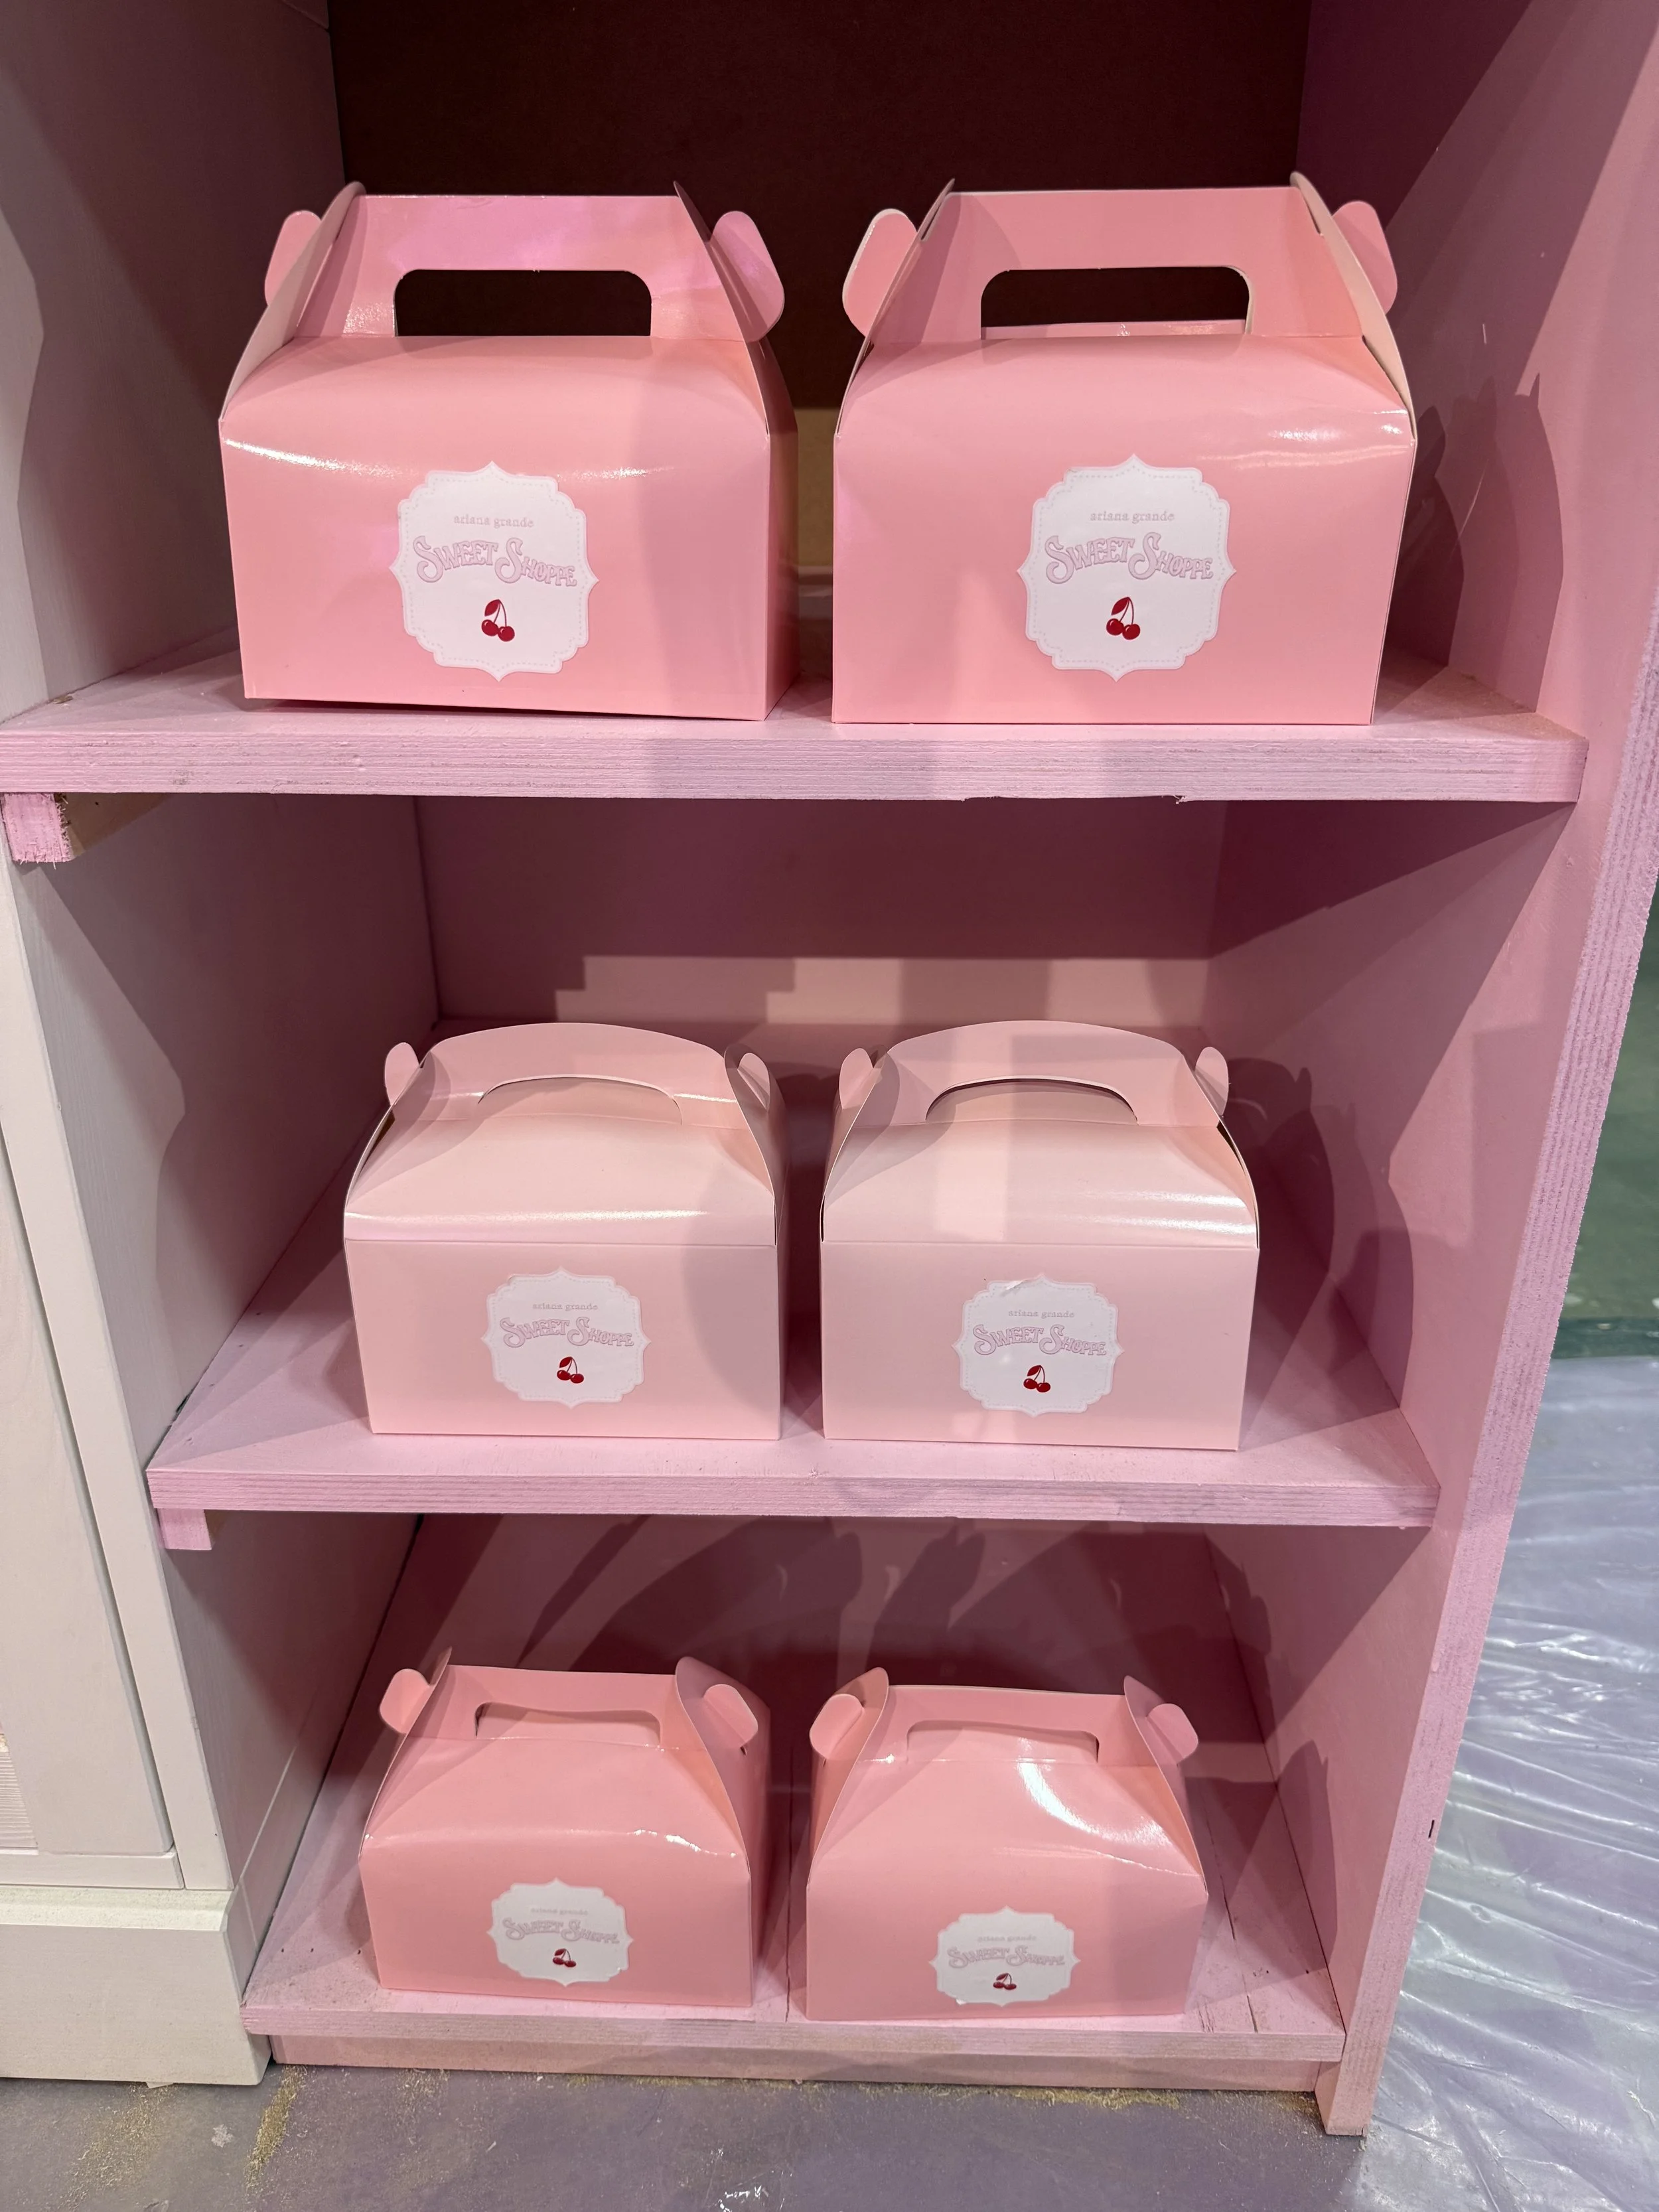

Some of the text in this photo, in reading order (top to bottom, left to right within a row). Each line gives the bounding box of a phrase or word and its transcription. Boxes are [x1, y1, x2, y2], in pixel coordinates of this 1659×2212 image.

[454, 514, 534, 528] ariana grande
[1090, 511, 1175, 524] ariana grande
[413, 536, 577, 586] SWEET SHOPPE
[1045, 532, 1214, 584] SWEET SHOPPE
[565, 1303, 598, 1311] grande
[1041, 1310, 1074, 1319] grande
[499, 1316, 634, 1348] SWEET SHOPPE
[973, 1324, 1107, 1356] SWEET SHOPPE
